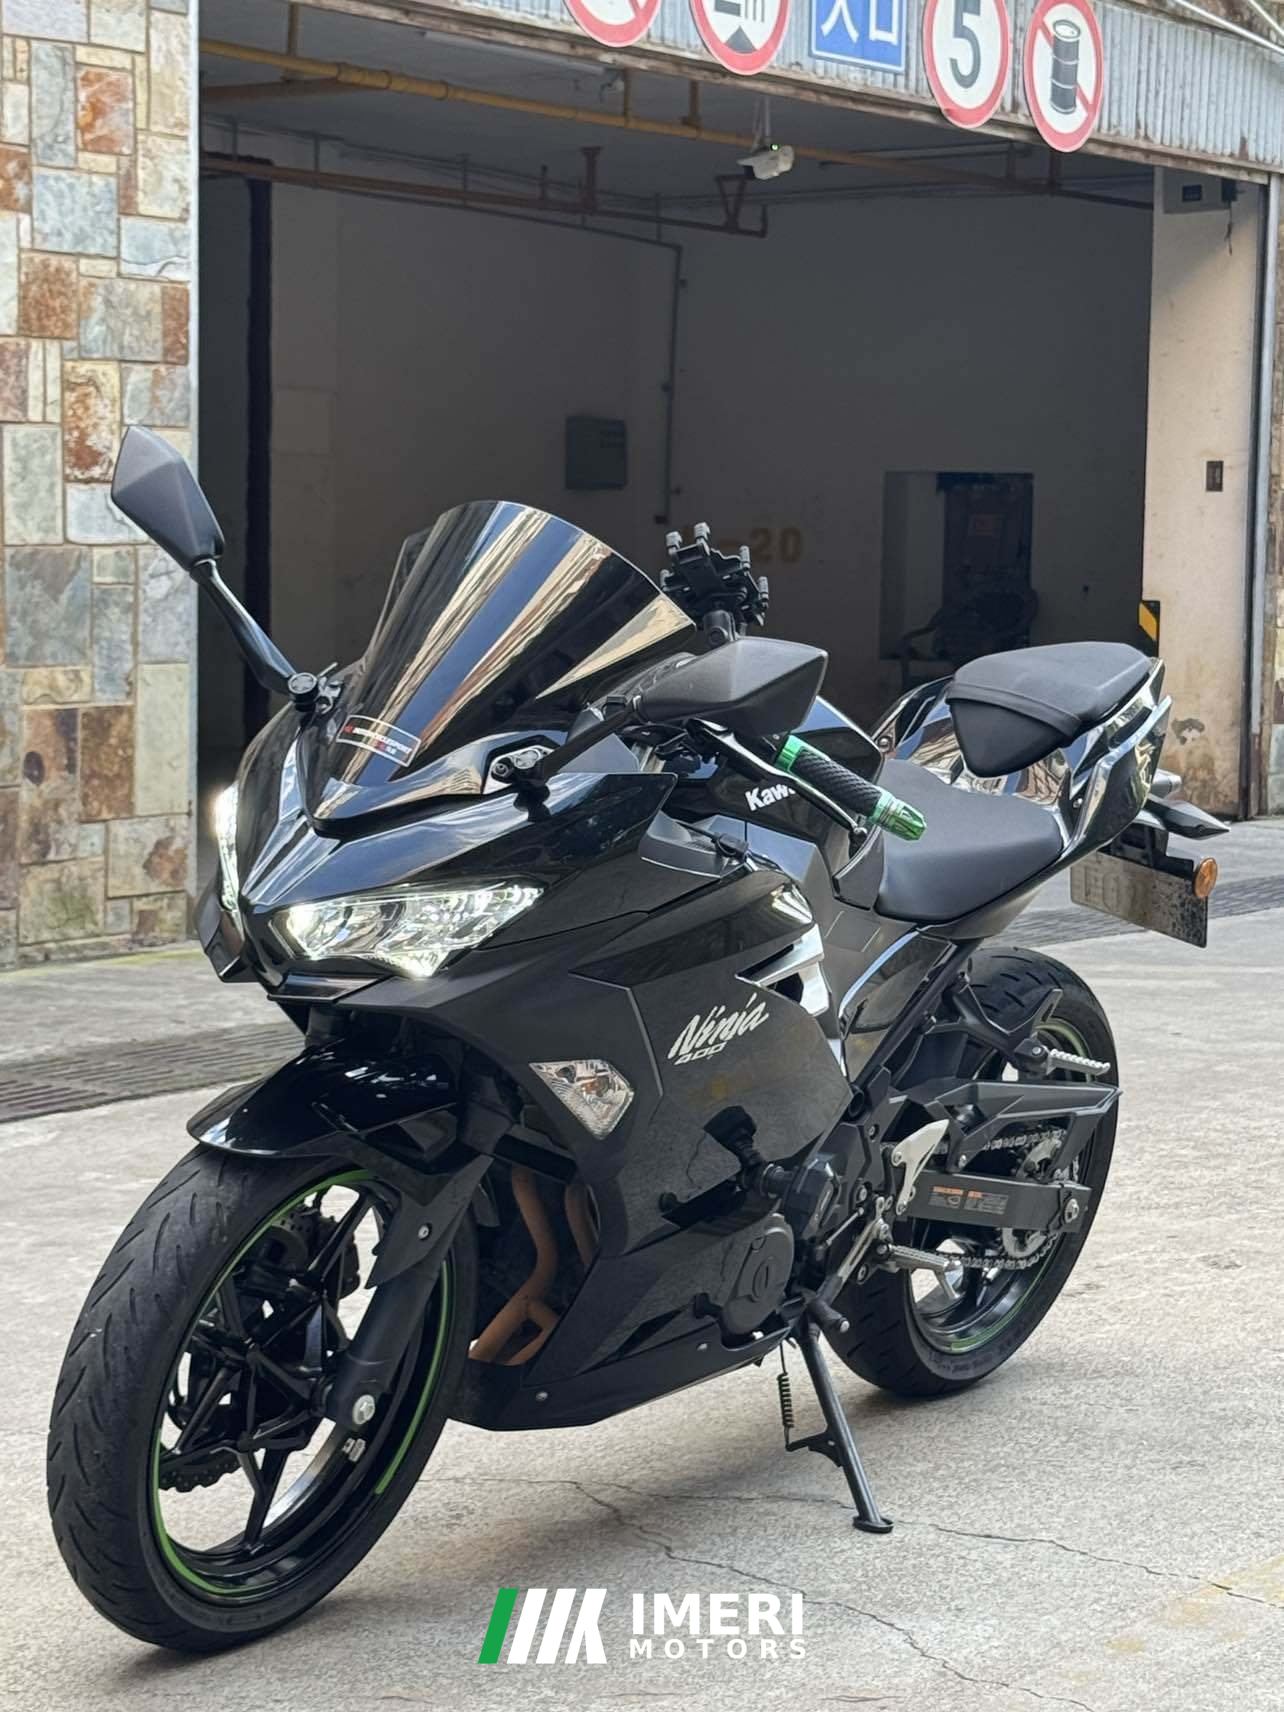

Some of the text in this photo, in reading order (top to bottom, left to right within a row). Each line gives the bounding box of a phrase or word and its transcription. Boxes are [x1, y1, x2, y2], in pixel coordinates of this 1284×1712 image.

[949, 0, 981, 89] 5
[667, 992, 769, 1060] Ninja
[673, 1040, 728, 1066] 400
